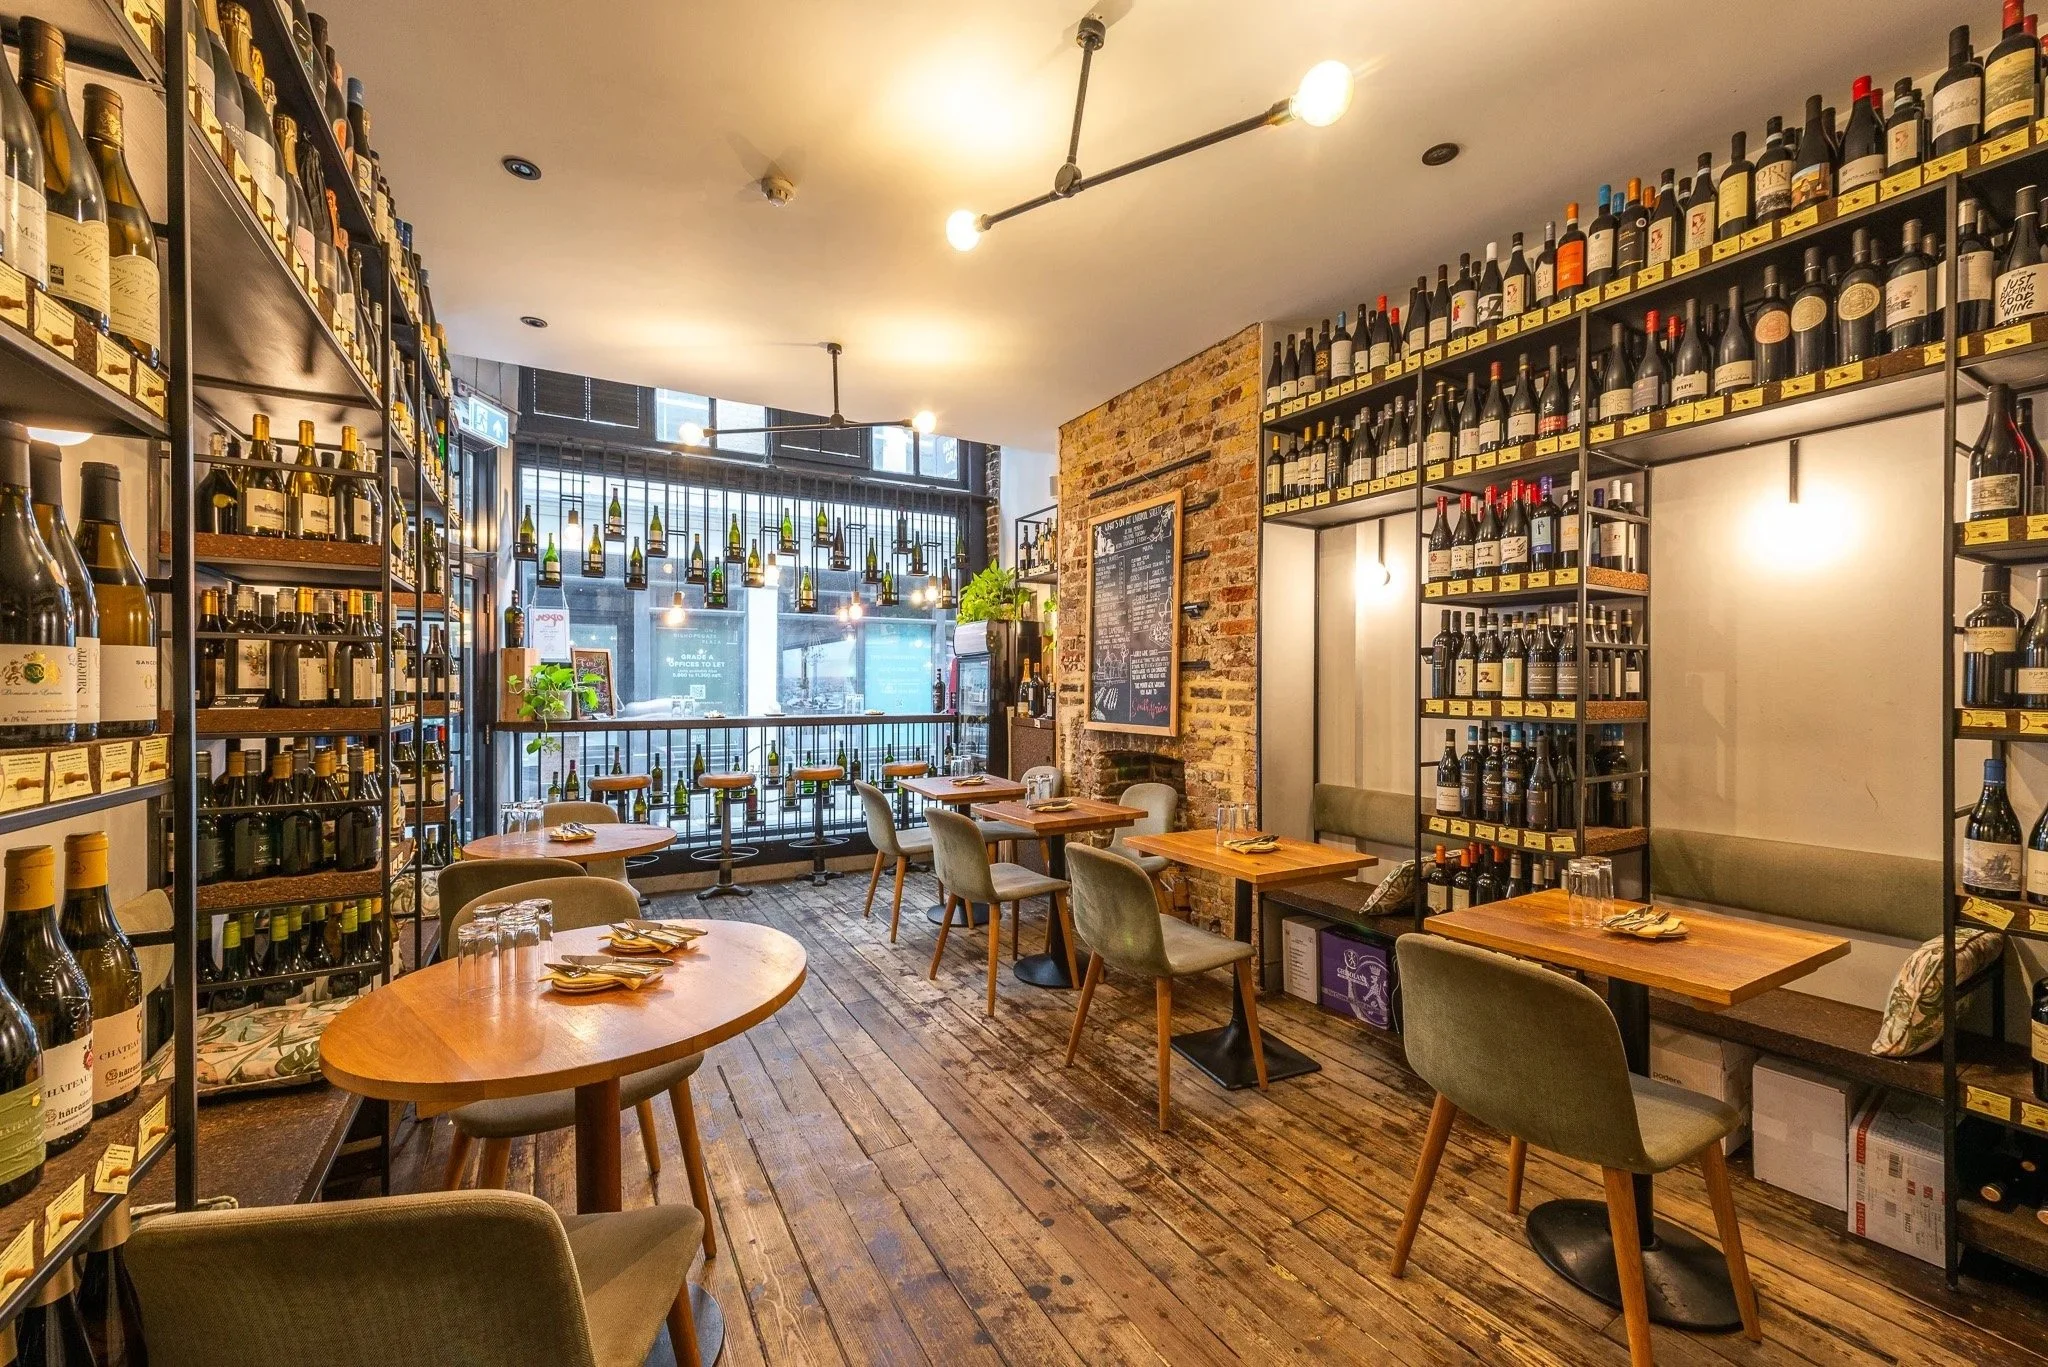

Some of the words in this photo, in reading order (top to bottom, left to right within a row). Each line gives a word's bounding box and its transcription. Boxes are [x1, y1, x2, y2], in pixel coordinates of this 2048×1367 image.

[2003, 272, 2037, 292] JUST
[2000, 291, 2035, 310] GOOD
[2004, 299, 2035, 317] WINE
[77, 647, 87, 694] Sancerre
